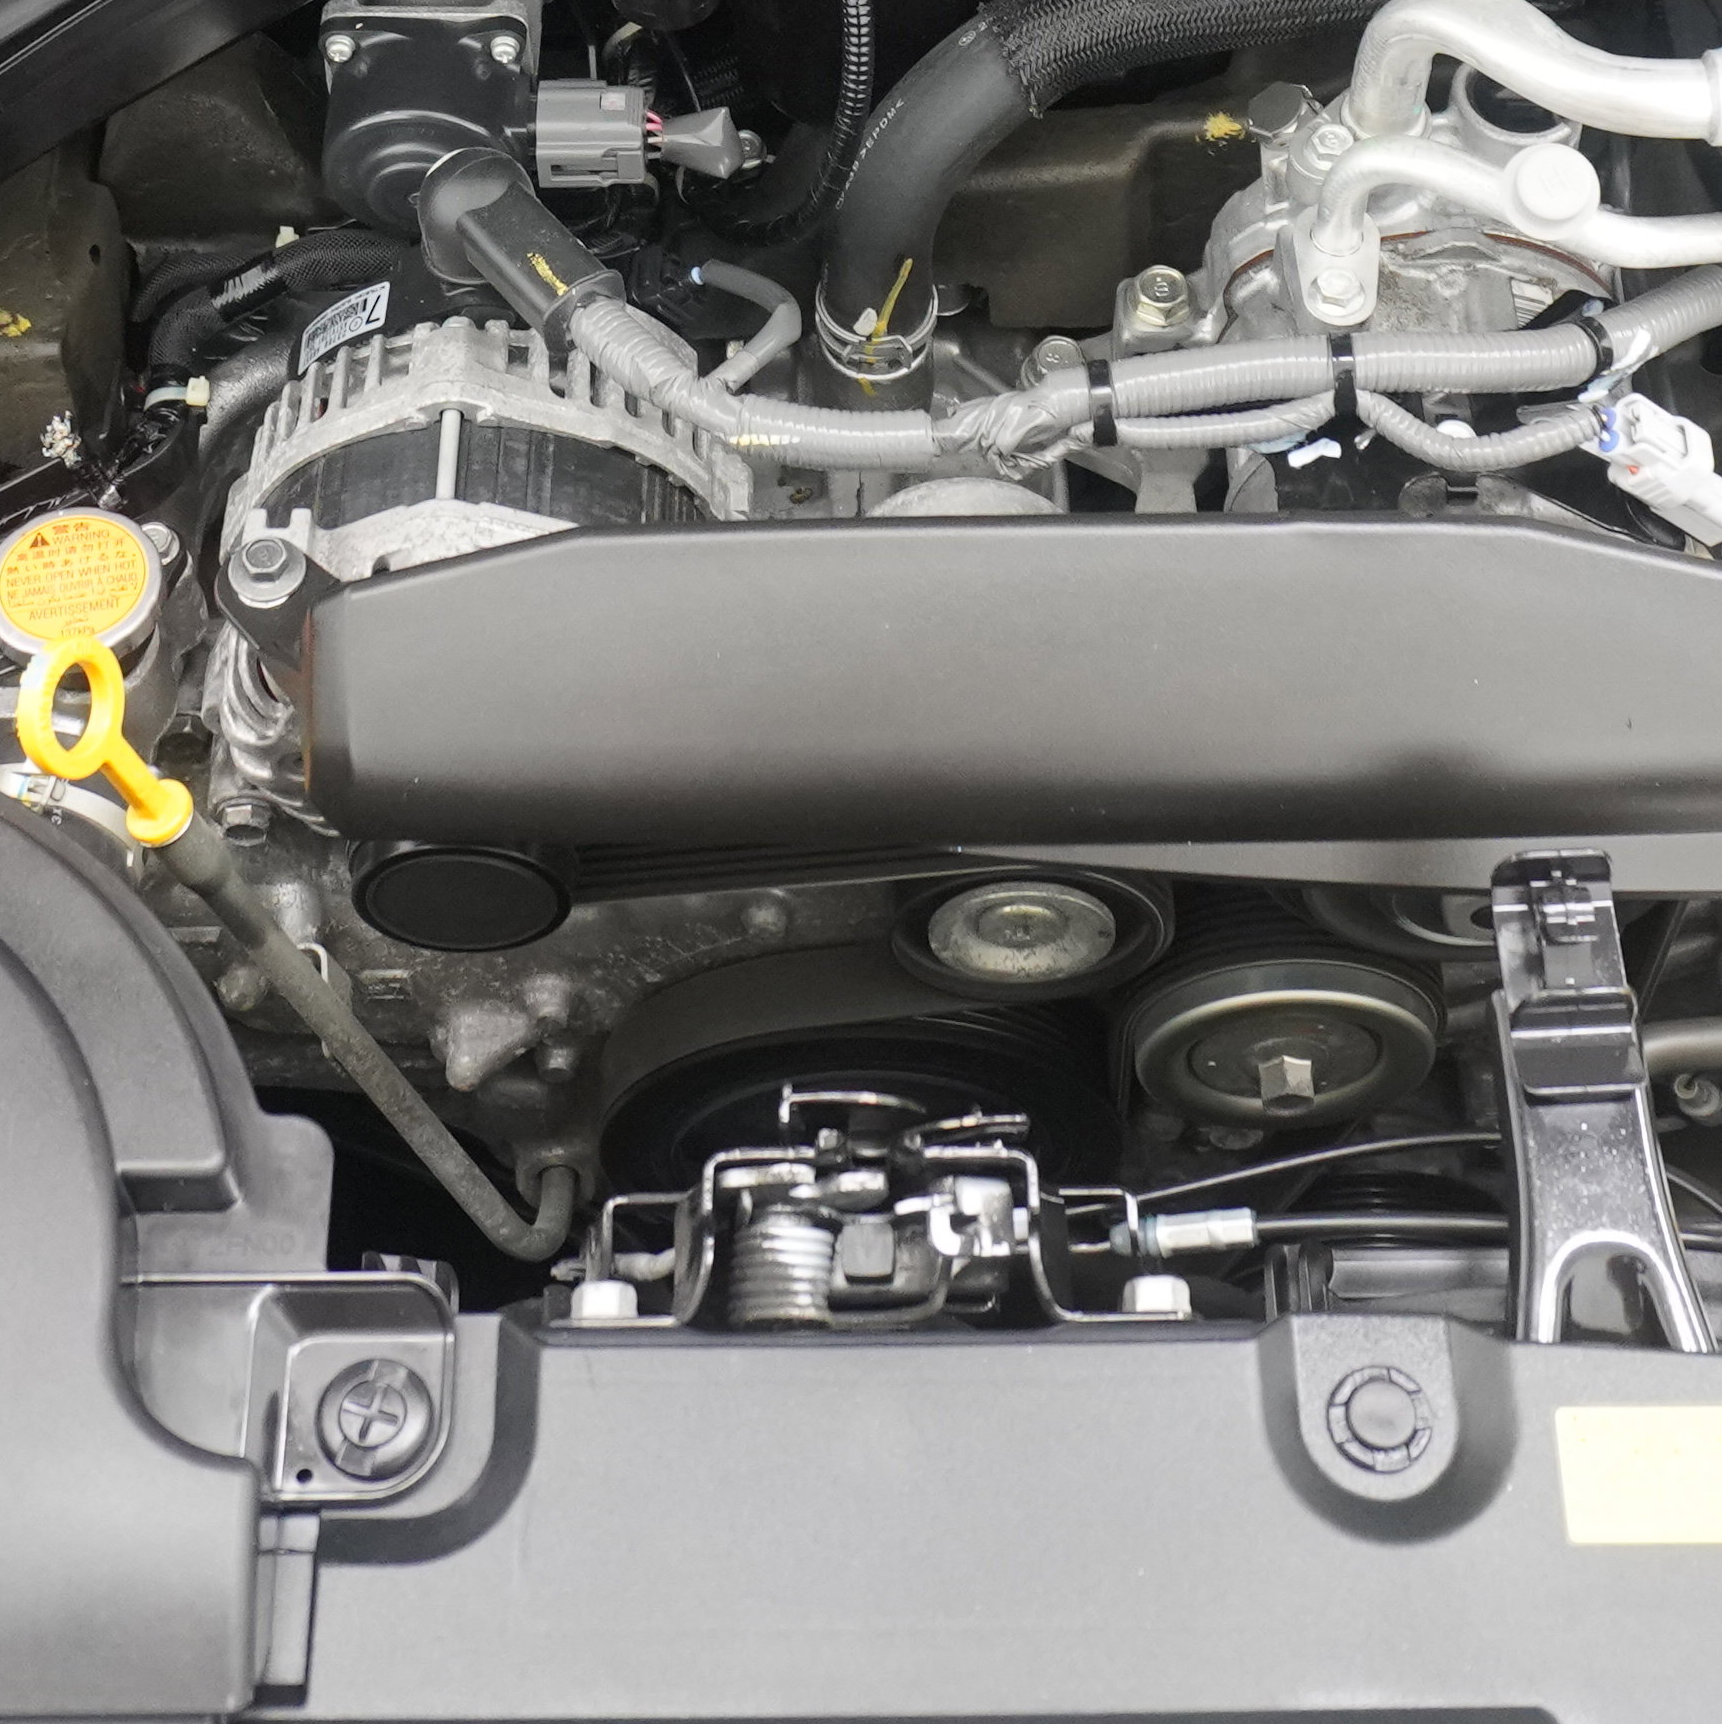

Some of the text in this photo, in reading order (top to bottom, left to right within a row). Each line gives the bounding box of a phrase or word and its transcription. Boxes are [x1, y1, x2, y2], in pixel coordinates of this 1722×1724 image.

[52, 529, 110, 545] WARNING
[6, 560, 137, 588] NEVER OPEN WHEN HOT
[28, 597, 121, 621] AVERTISSEMENT
